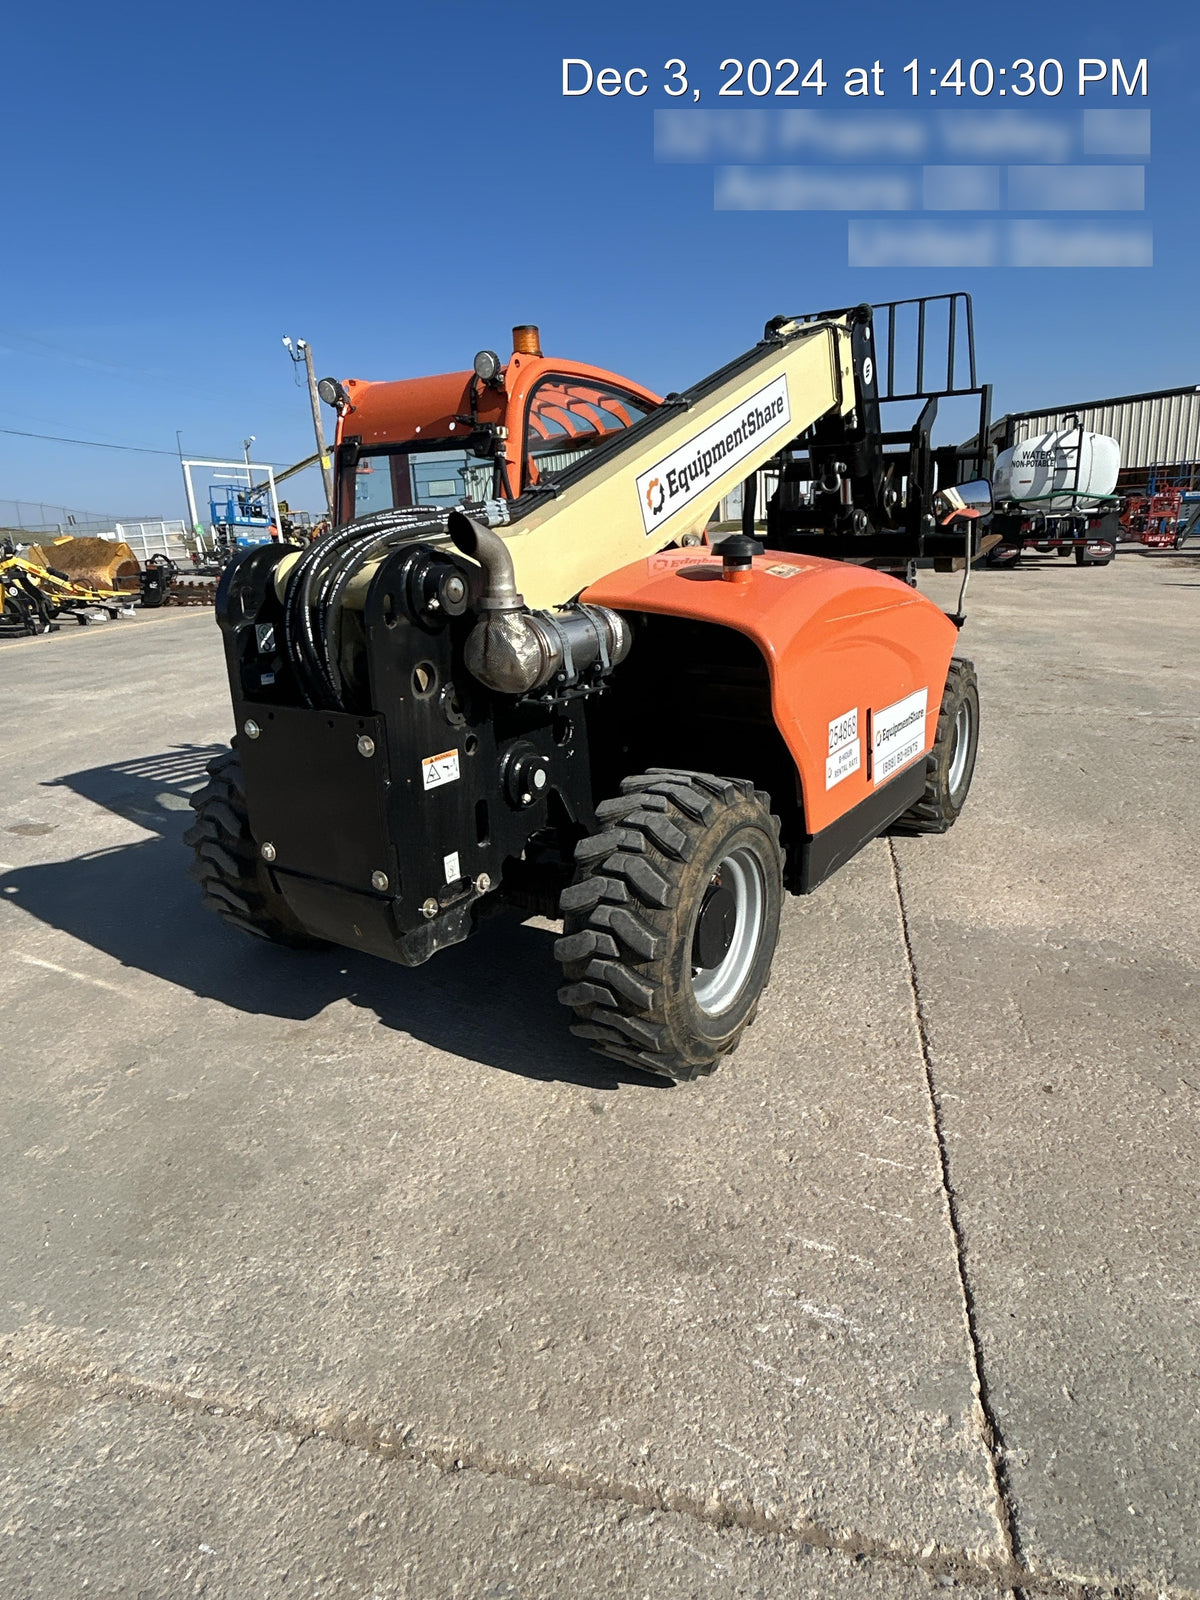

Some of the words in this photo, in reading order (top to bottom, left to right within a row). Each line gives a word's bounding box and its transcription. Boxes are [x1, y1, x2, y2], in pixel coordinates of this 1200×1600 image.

[665, 396, 784, 499] EquipmentShare
[1011, 459, 1055, 468] NON-POTABLE
[1022, 450, 1053, 460] WATER
[829, 715, 857, 749] 254868
[882, 708, 925, 742] EquipmentShare
